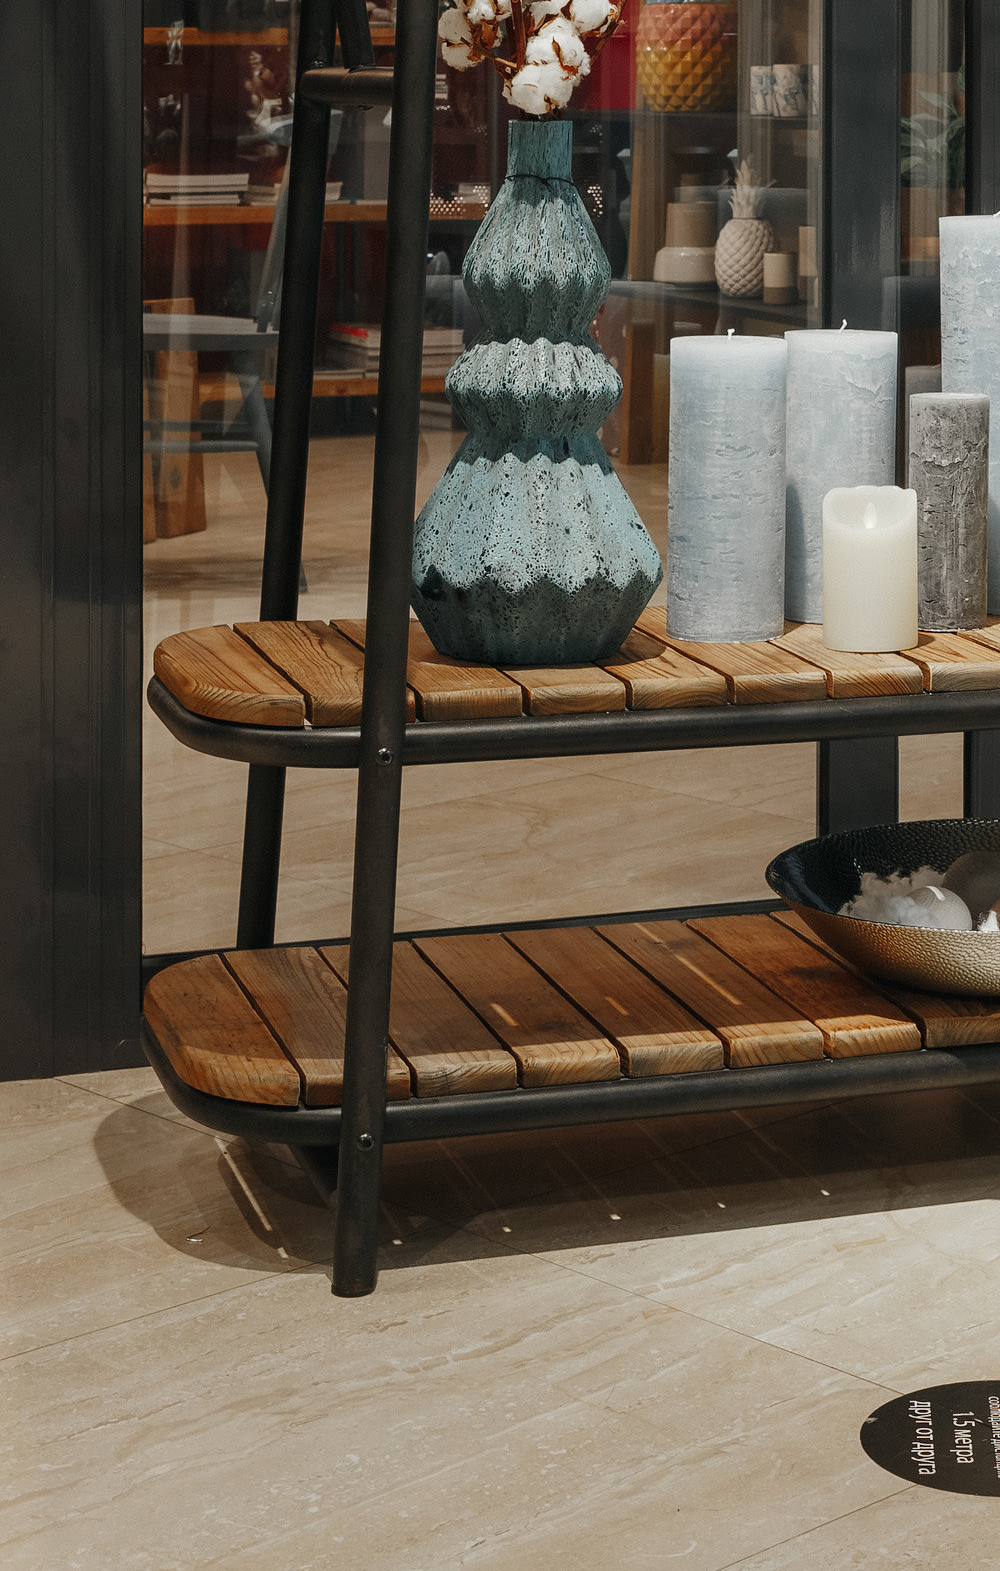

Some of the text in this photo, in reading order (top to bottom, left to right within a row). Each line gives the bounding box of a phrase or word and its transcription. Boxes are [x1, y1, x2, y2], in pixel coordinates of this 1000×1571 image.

[908, 1400, 936, 1475] друг от друга
[949, 1429, 974, 1464] метра
